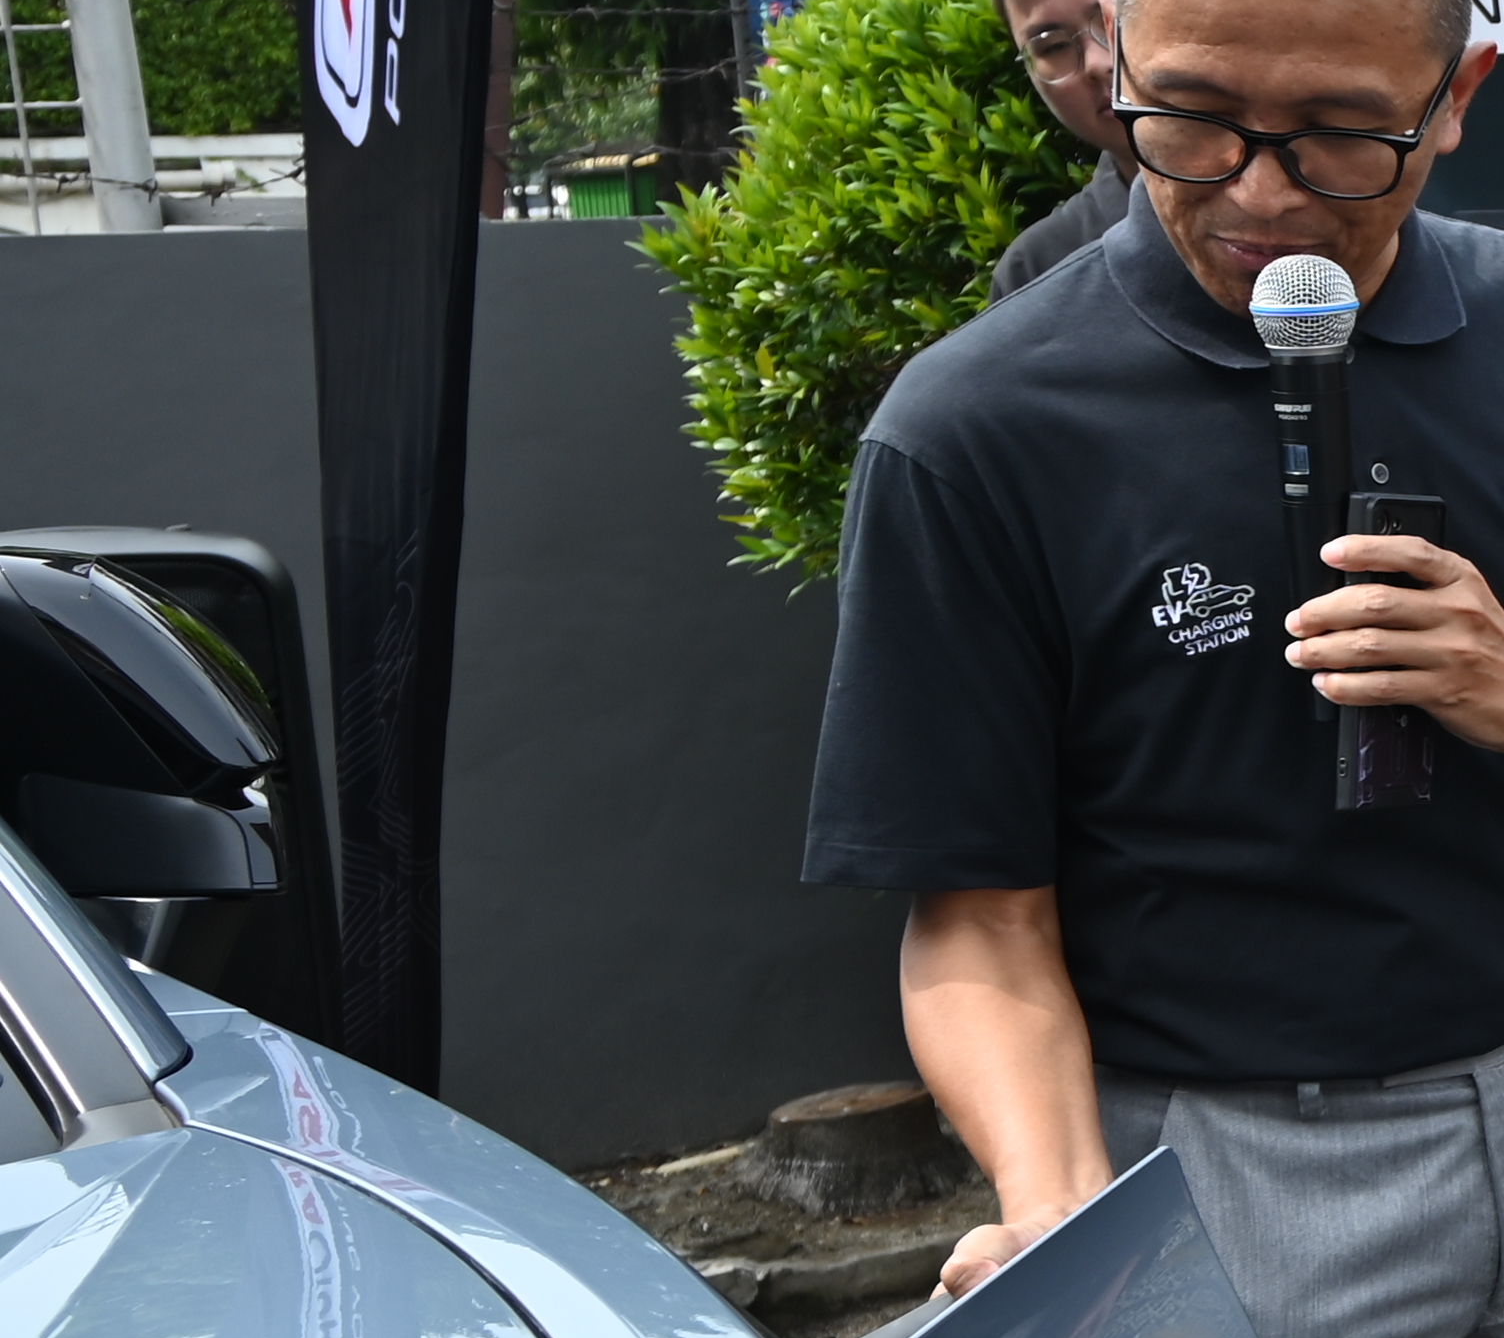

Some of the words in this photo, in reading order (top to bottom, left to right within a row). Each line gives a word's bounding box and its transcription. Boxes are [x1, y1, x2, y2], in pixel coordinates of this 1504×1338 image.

[1151, 601, 1183, 627] EV
[1168, 607, 1254, 643] CHARGING
[1184, 625, 1251, 656] STATION
